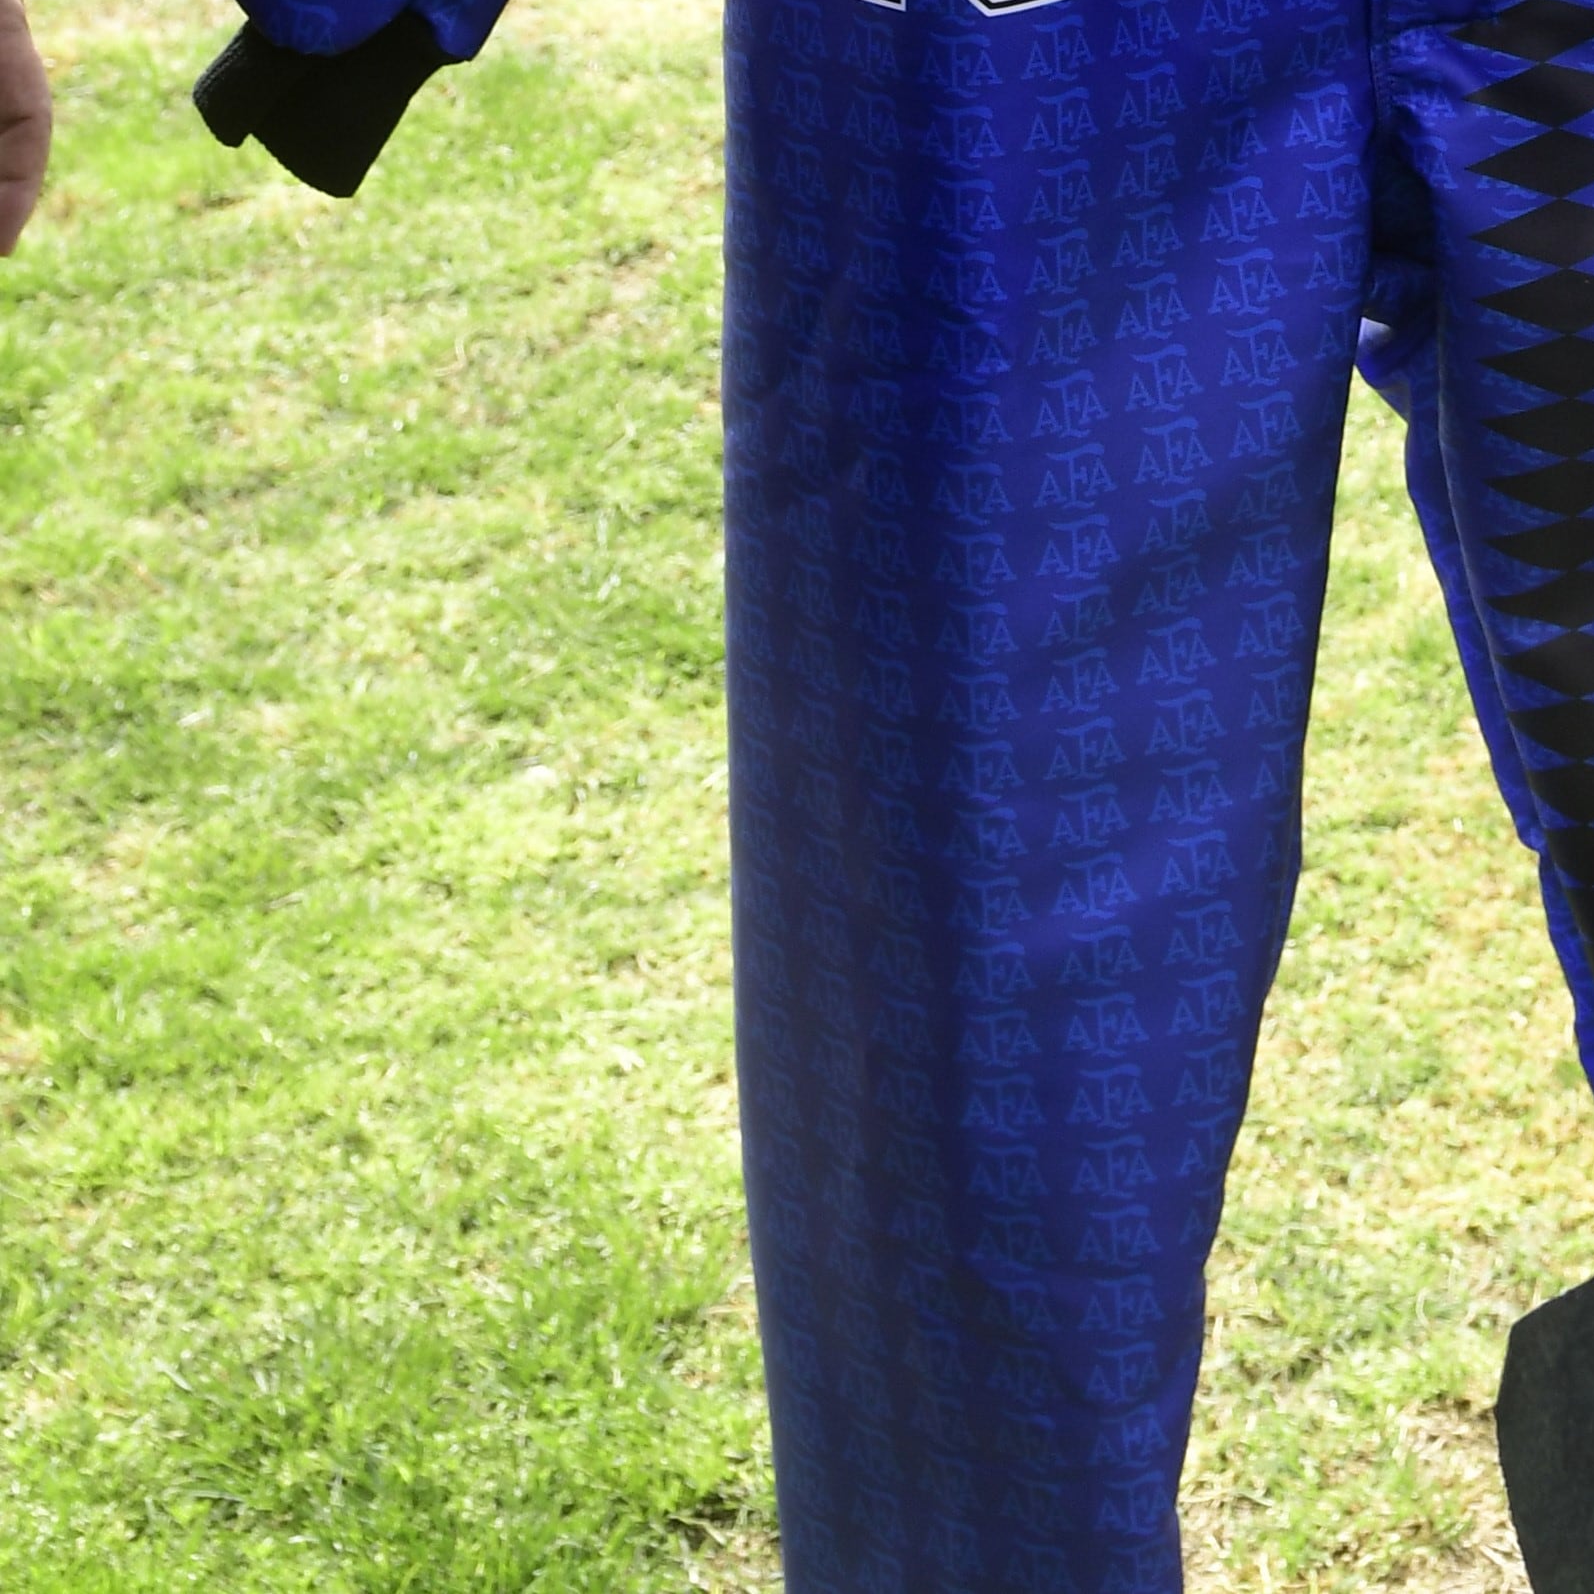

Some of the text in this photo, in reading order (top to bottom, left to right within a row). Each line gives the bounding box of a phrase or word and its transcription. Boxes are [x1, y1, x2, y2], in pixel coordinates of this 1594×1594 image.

[1021, 84, 1100, 153] AFA
[1274, 83, 1360, 147] AFA
[1188, 177, 1274, 241] AFA
[1293, 151, 1372, 220] AFA
[1111, 270, 1190, 339] AFA
[1197, 249, 1283, 313] AFA
[1121, 343, 1200, 412] AFA
[1217, 317, 1296, 386] AFA
[1027, 371, 1108, 437] AFA
[1226, 389, 1305, 458] AFA
[1034, 440, 1113, 509] AFA
[1131, 415, 1210, 484] AFA
[1134, 616, 1213, 685] AFA
[1144, 687, 1223, 756] AFA
[1157, 827, 1236, 896] AFA
[1162, 898, 1241, 967] AFA
[957, 937, 1035, 1008] AFA
[961, 1143, 1043, 1201] AFA
